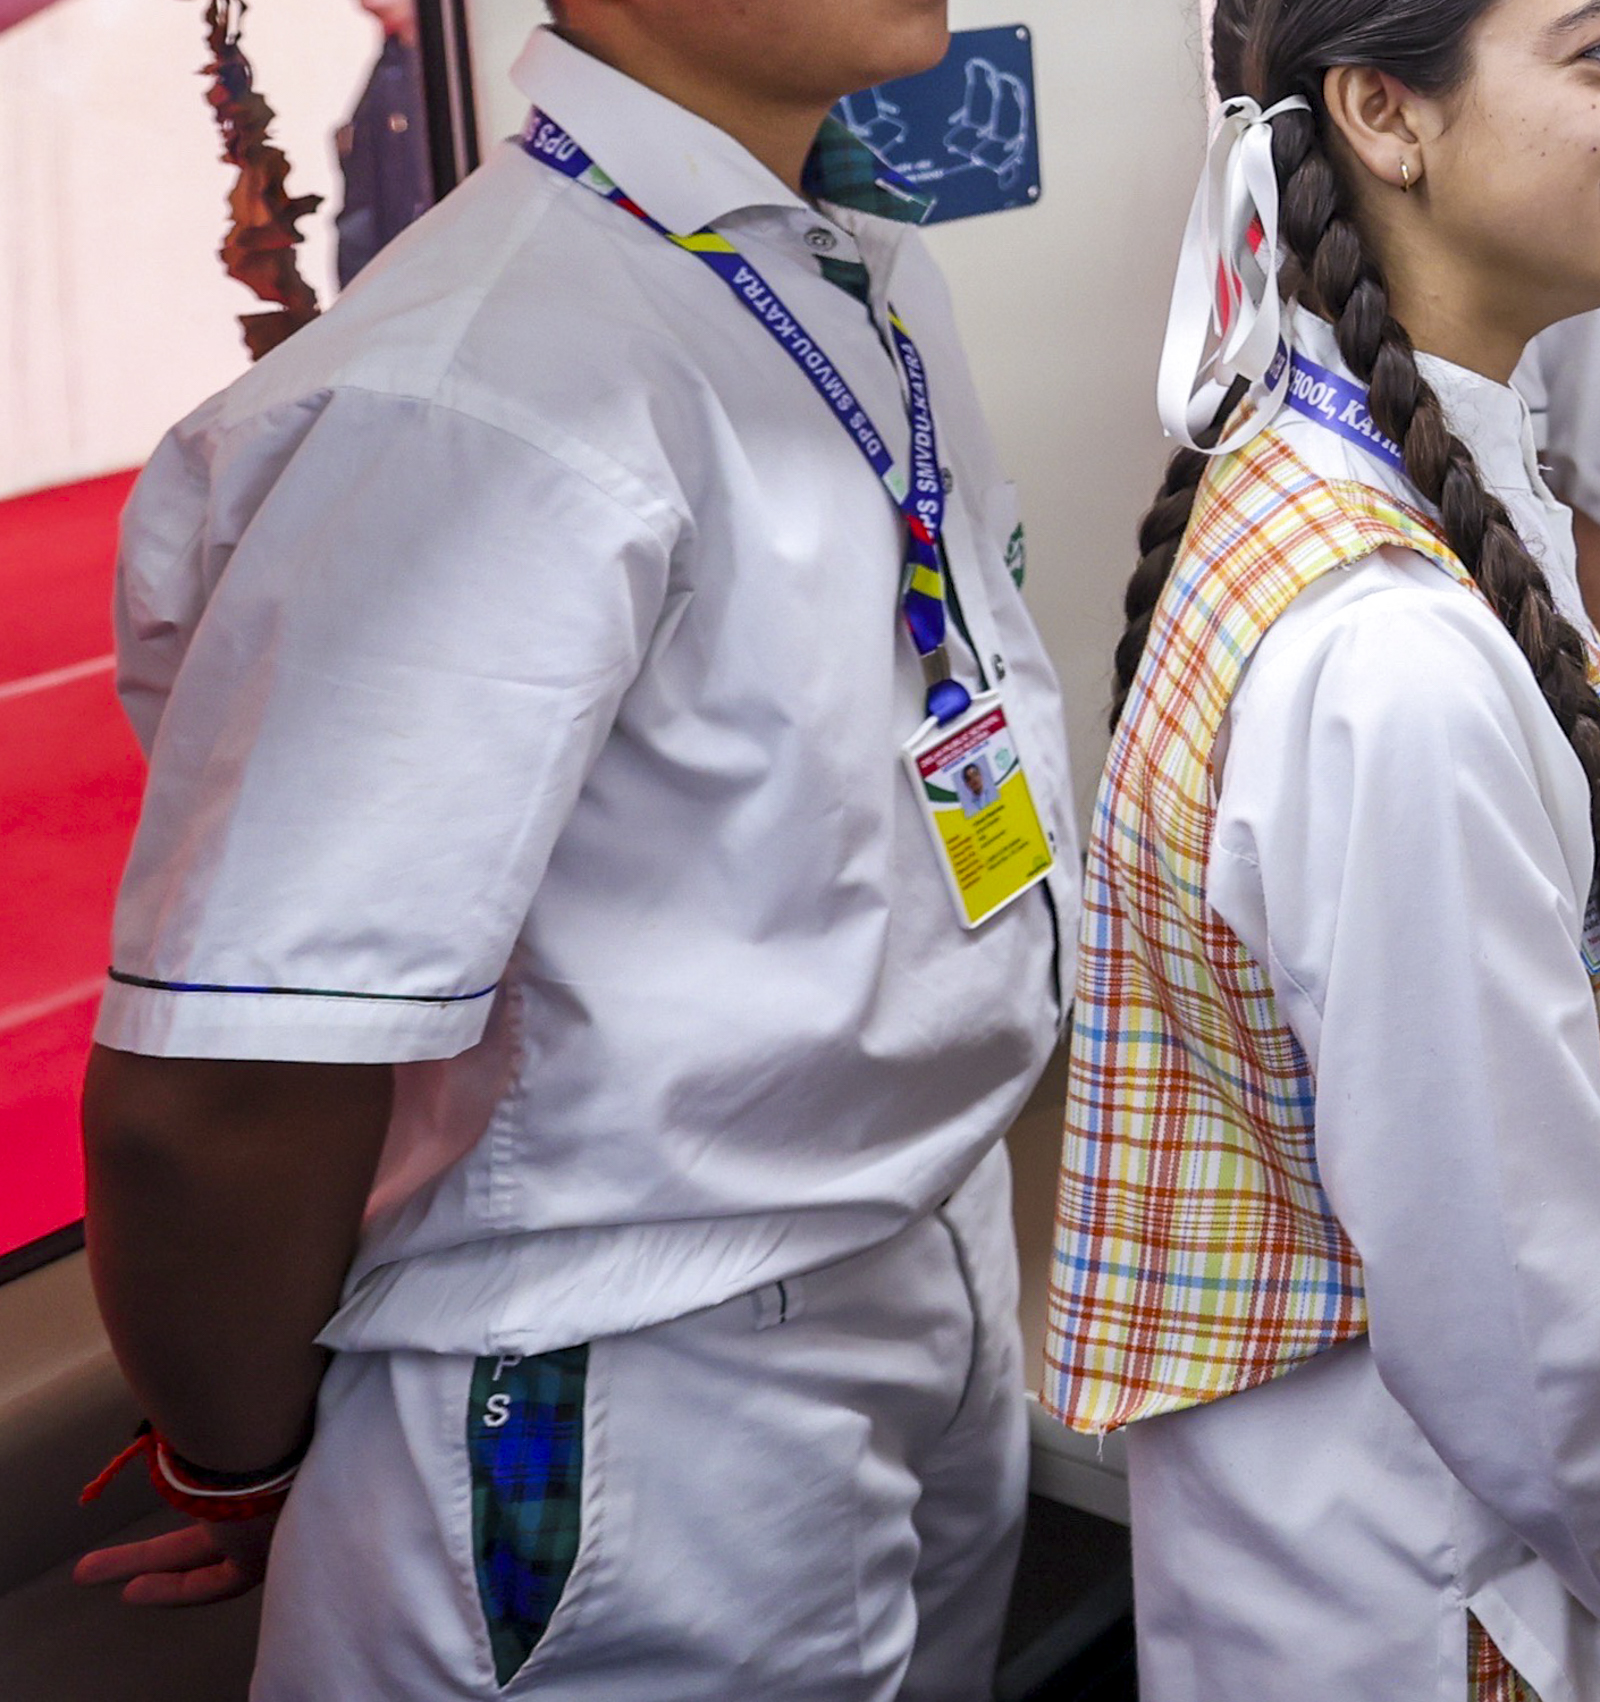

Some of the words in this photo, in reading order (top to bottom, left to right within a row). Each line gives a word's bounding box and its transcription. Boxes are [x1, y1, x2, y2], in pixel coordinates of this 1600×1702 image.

[732, 265, 854, 412] SMVDU-KATRA
[900, 343, 939, 494] SMVDU-KATRA
[1289, 365, 1337, 420] HOOL,
[849, 412, 882, 457] DPS
[916, 499, 939, 539] PS
